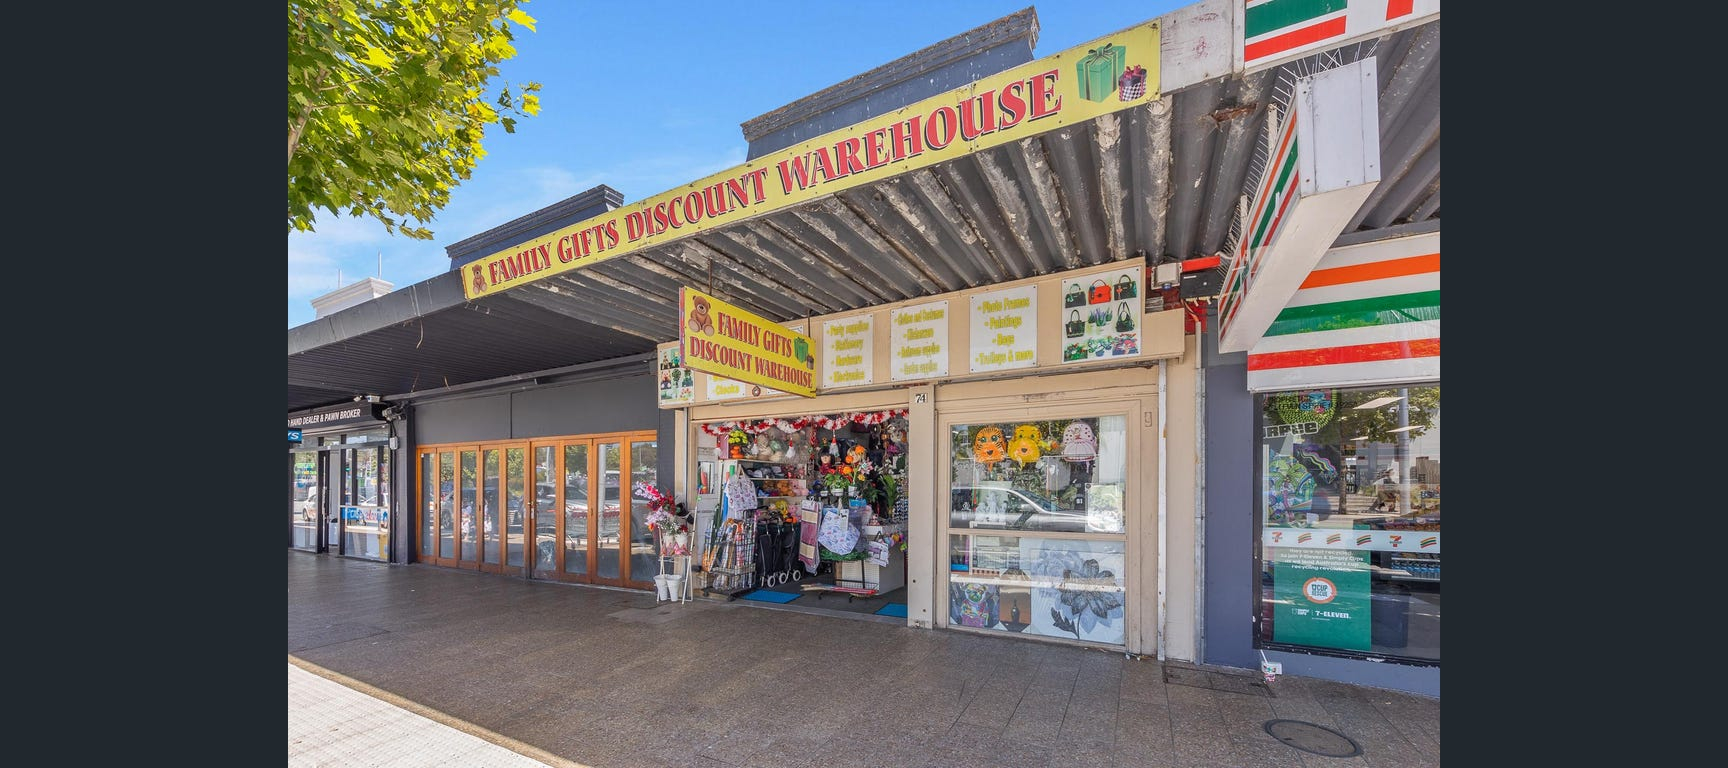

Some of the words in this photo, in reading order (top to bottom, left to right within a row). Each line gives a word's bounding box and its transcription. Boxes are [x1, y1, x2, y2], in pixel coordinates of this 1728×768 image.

[488, 242, 552, 285] FAMILY
[558, 218, 620, 264] GIFTS
[625, 168, 769, 242] DISCOUNT
[776, 69, 1063, 195] WAREHOUSE
[982, 300, 1002, 314] Photo
[1004, 297, 1030, 311] Frames
[990, 316, 1022, 330] Paintings
[718, 312, 762, 347] FAMILY
[763, 331, 792, 358] GIFTS
[690, 336, 752, 372] DISCOUNT
[755, 356, 812, 388] WAREHOUSE
[915, 393, 925, 403] 74
[290, 418, 302, 426] HAND
[303, 414, 320, 424] DEALER
[324, 412, 340, 422] PAWN
[340, 408, 360, 419] BROKER
